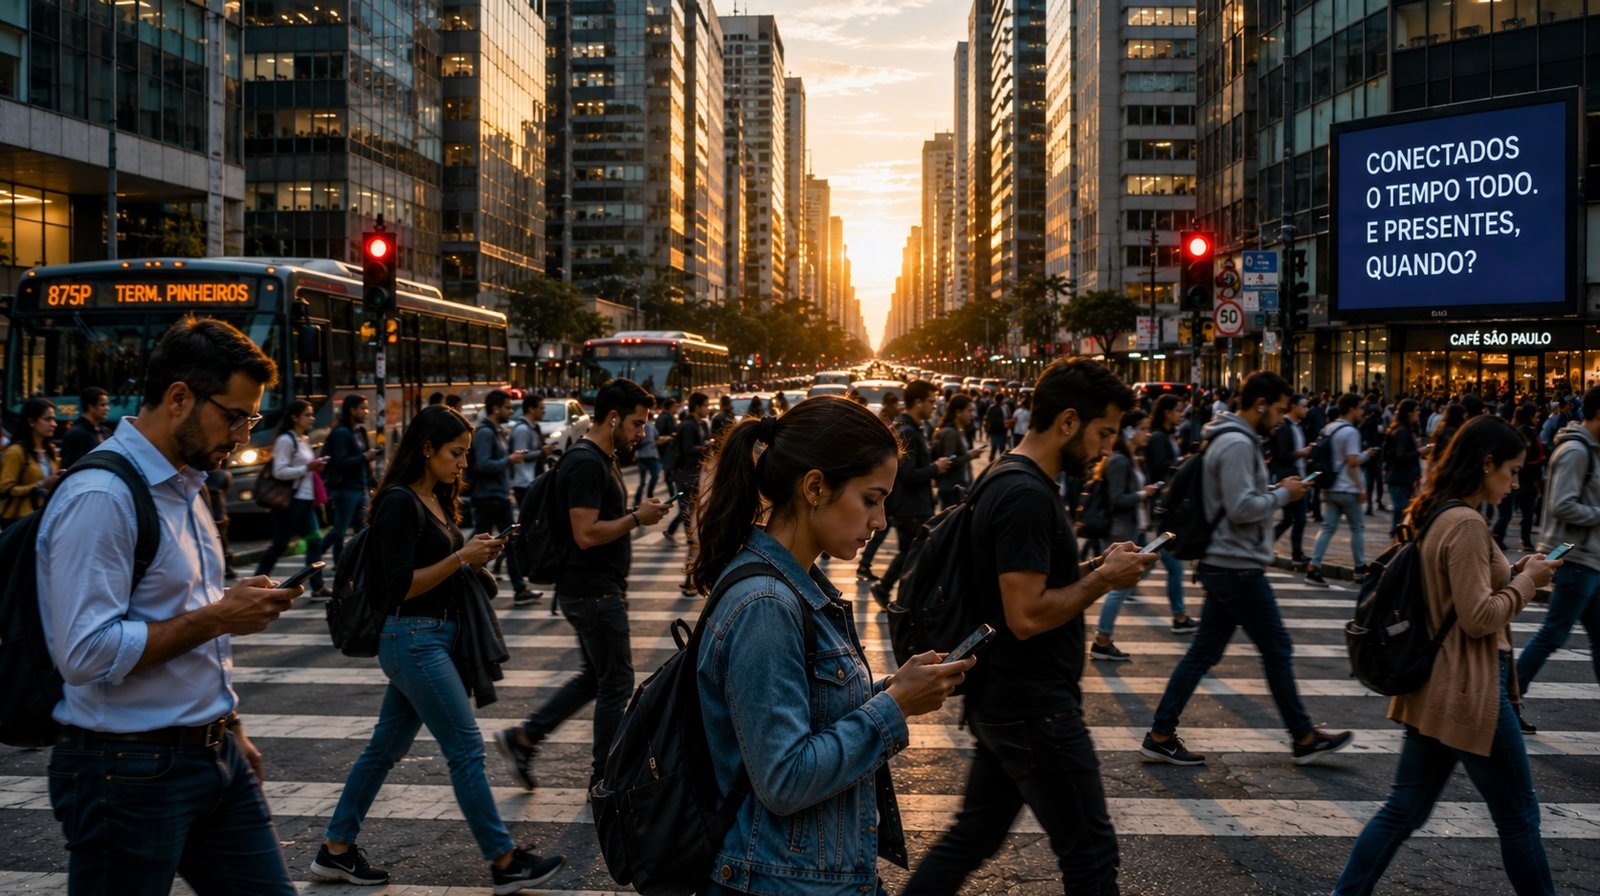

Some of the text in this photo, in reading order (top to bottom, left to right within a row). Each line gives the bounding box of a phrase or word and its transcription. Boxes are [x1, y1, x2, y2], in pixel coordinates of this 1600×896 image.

[1366, 135, 1520, 175] CONECTADOS
[1366, 172, 1538, 209] O TEMPO TODO.
[1367, 210, 1521, 244] E PRESENTES,
[1366, 249, 1477, 281] QUANDO?
[47, 283, 249, 306] 875P TERM. PINHEIROS
[1220, 309, 1238, 324] 50
[1450, 330, 1552, 346] CAFÉ SÃO PAULO
